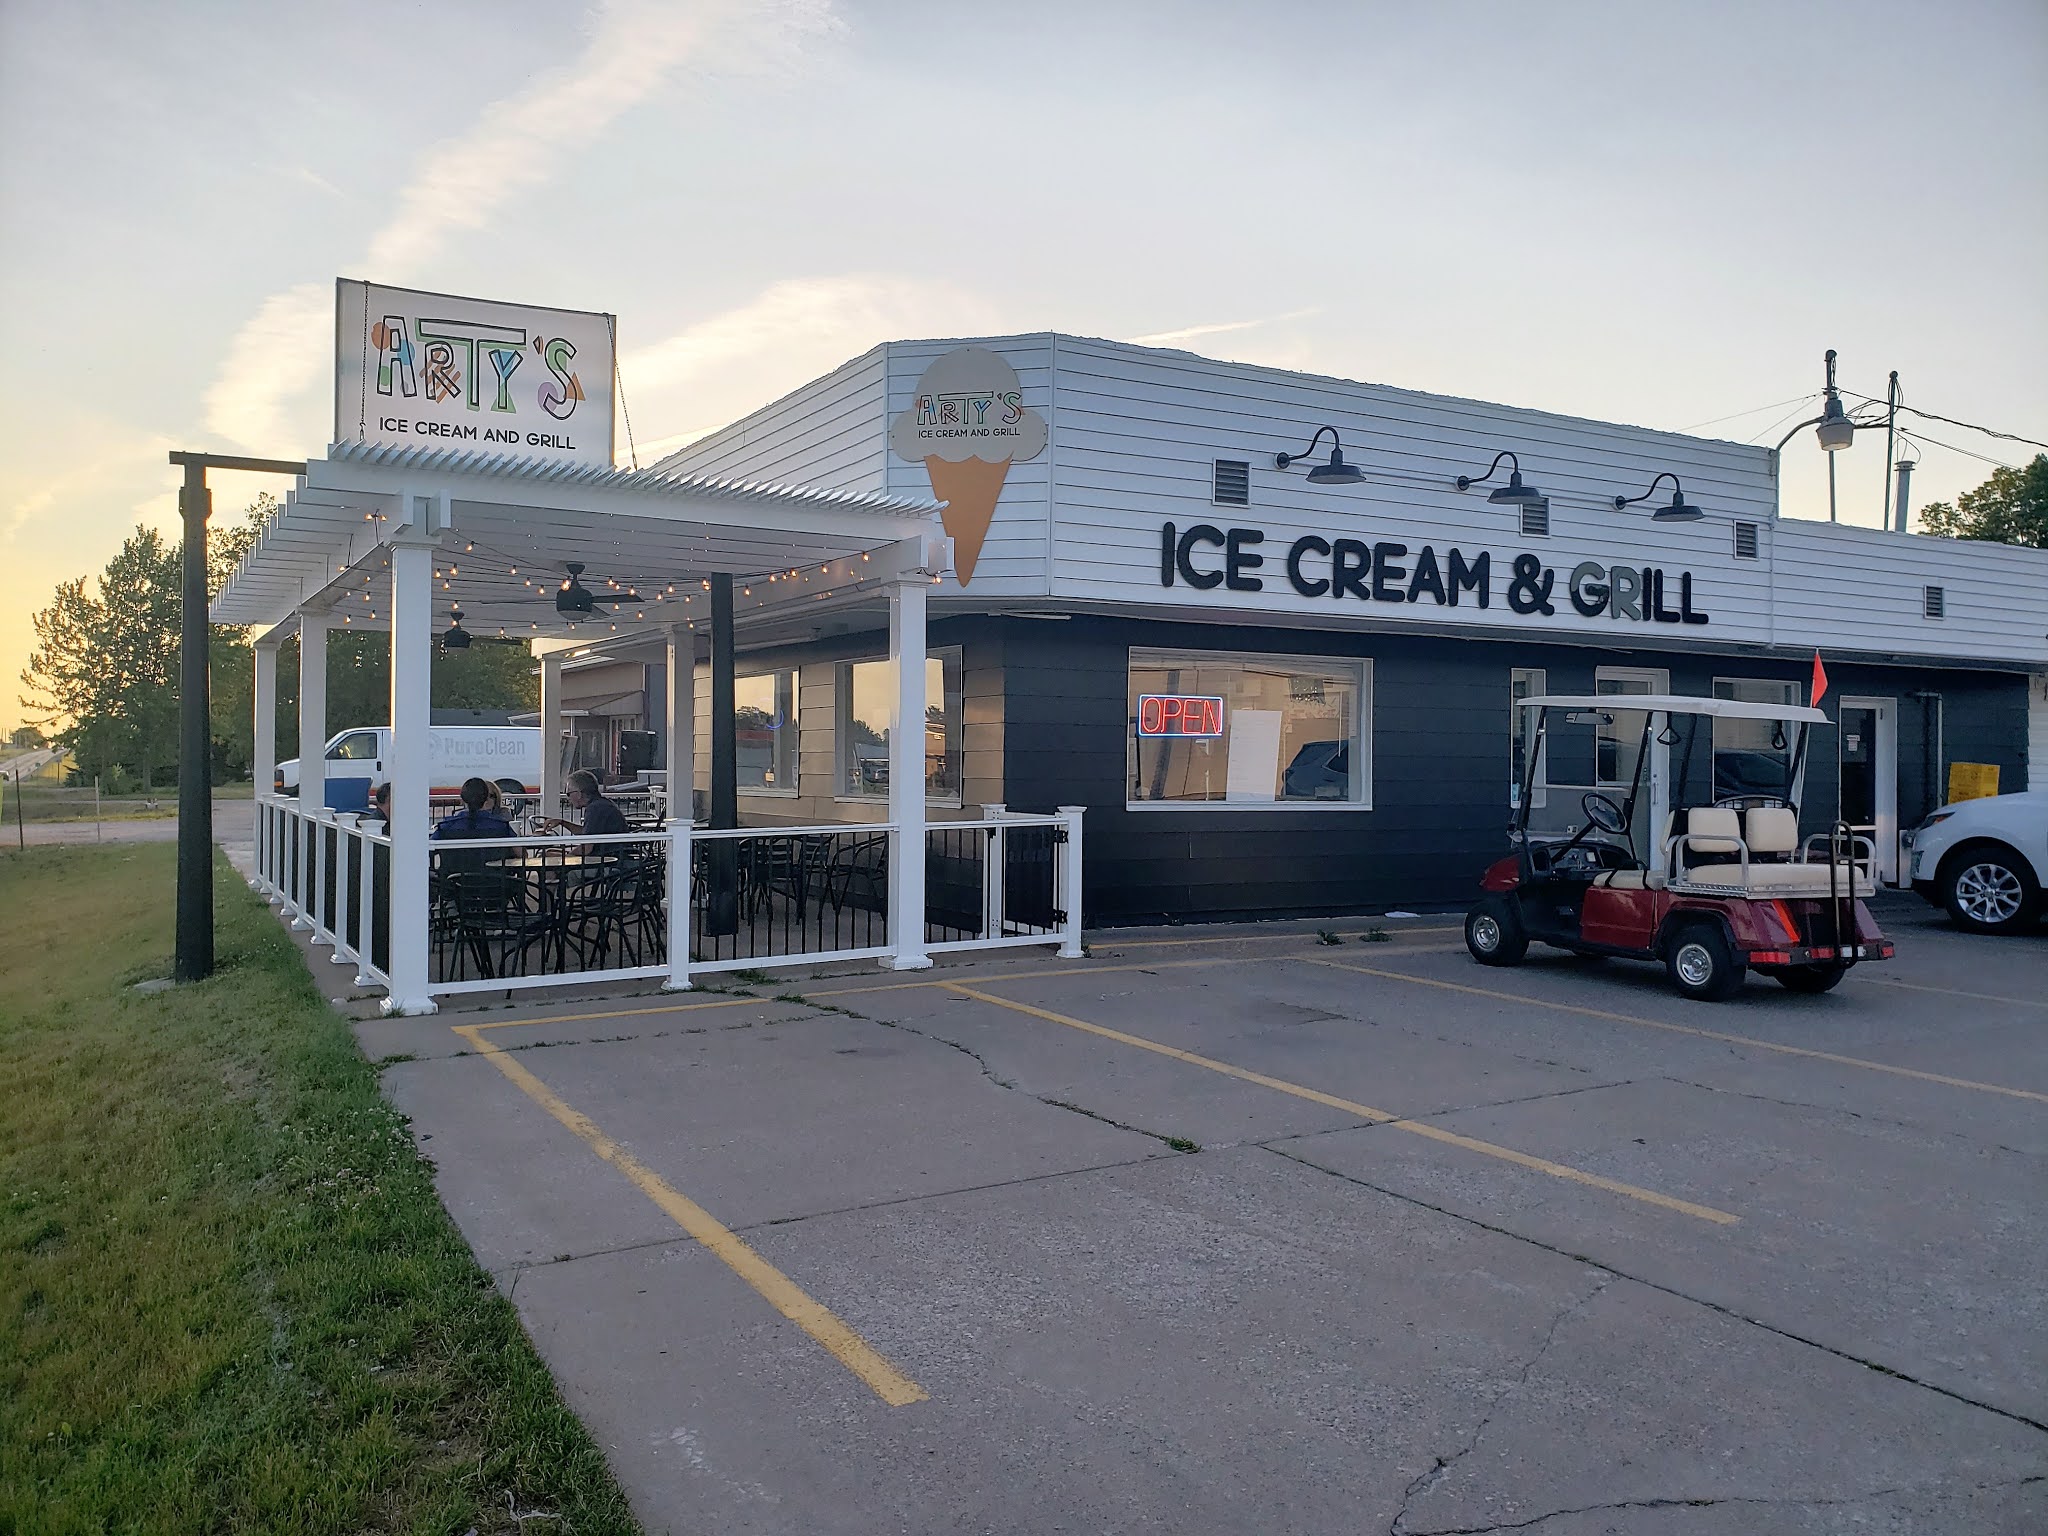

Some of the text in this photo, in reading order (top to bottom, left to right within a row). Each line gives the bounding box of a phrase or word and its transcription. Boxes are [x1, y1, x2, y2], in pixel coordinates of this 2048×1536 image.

[376, 315, 578, 421] ARTY'S
[917, 391, 1022, 425] ARTY'S
[379, 417, 577, 450] ICE CREAM AND GRILL
[918, 427, 1021, 439] ICE CREAM AND GRILL
[1161, 521, 1710, 625] ICE CREAM & GRILL
[1141, 697, 1222, 735] OPEN
[444, 737, 526, 755] PuroClean
